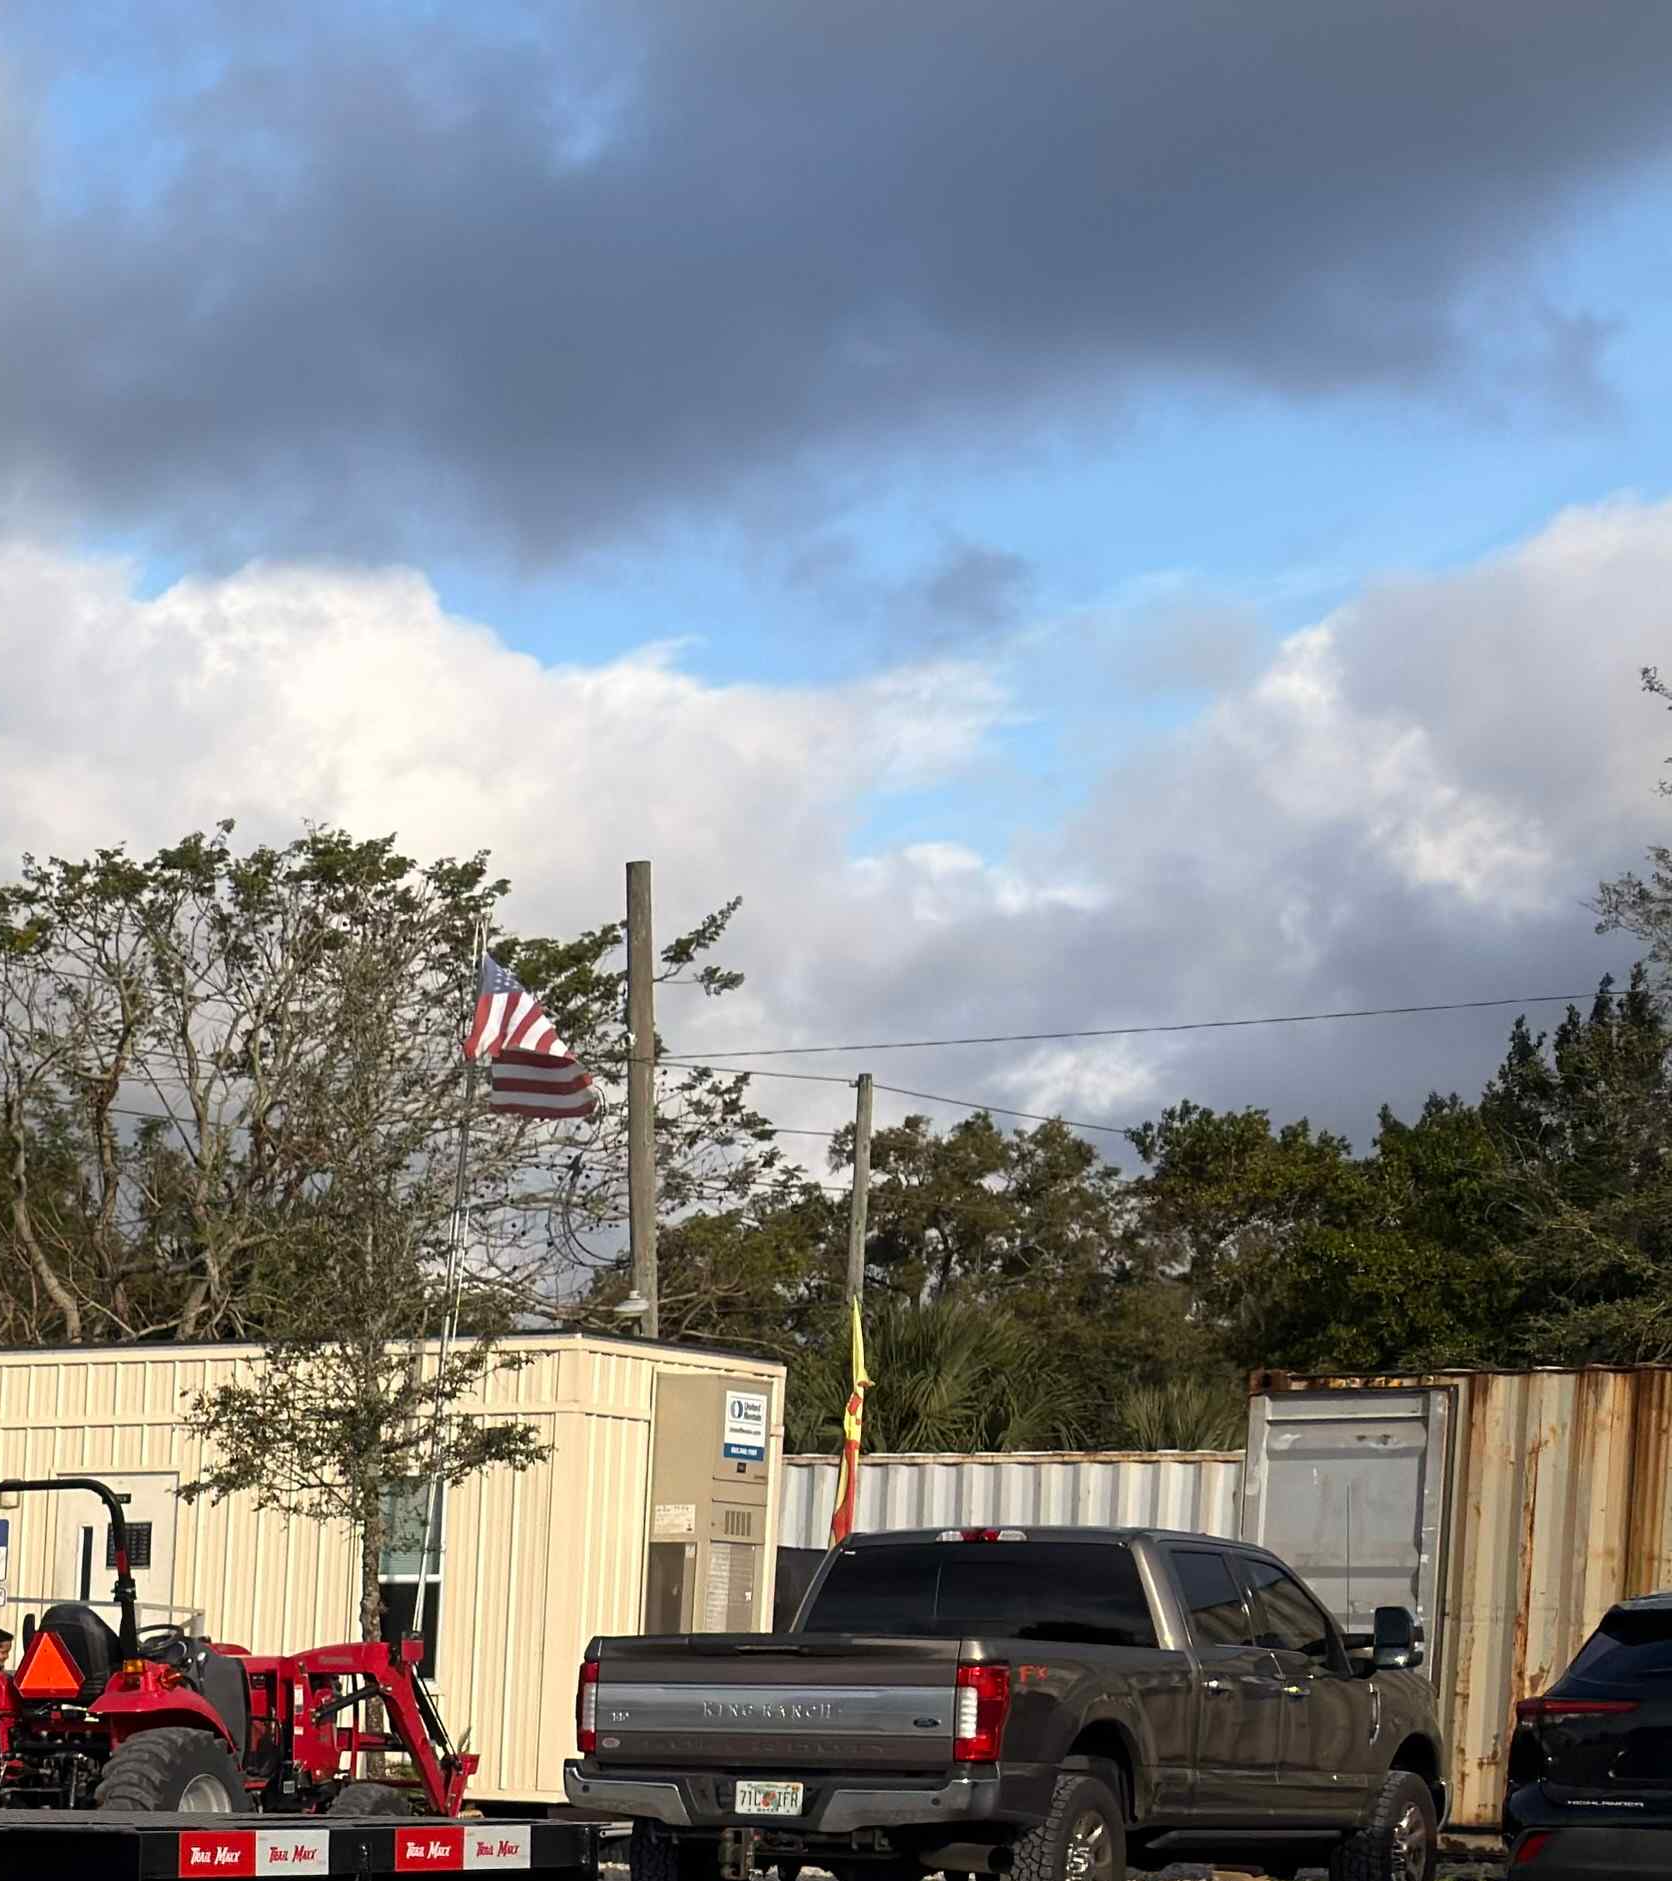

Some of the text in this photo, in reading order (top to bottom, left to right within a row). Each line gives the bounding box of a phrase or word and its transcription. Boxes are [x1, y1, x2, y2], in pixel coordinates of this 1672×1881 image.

[703, 1700, 832, 1720] KING RANCH
[191, 1846, 241, 1864] TRAIL MAXX
[268, 1844, 318, 1863] TRAIL MAXX
[406, 1841, 452, 1858] TRAIL MAXX
[476, 1840, 520, 1856] TRAIL MAXX
